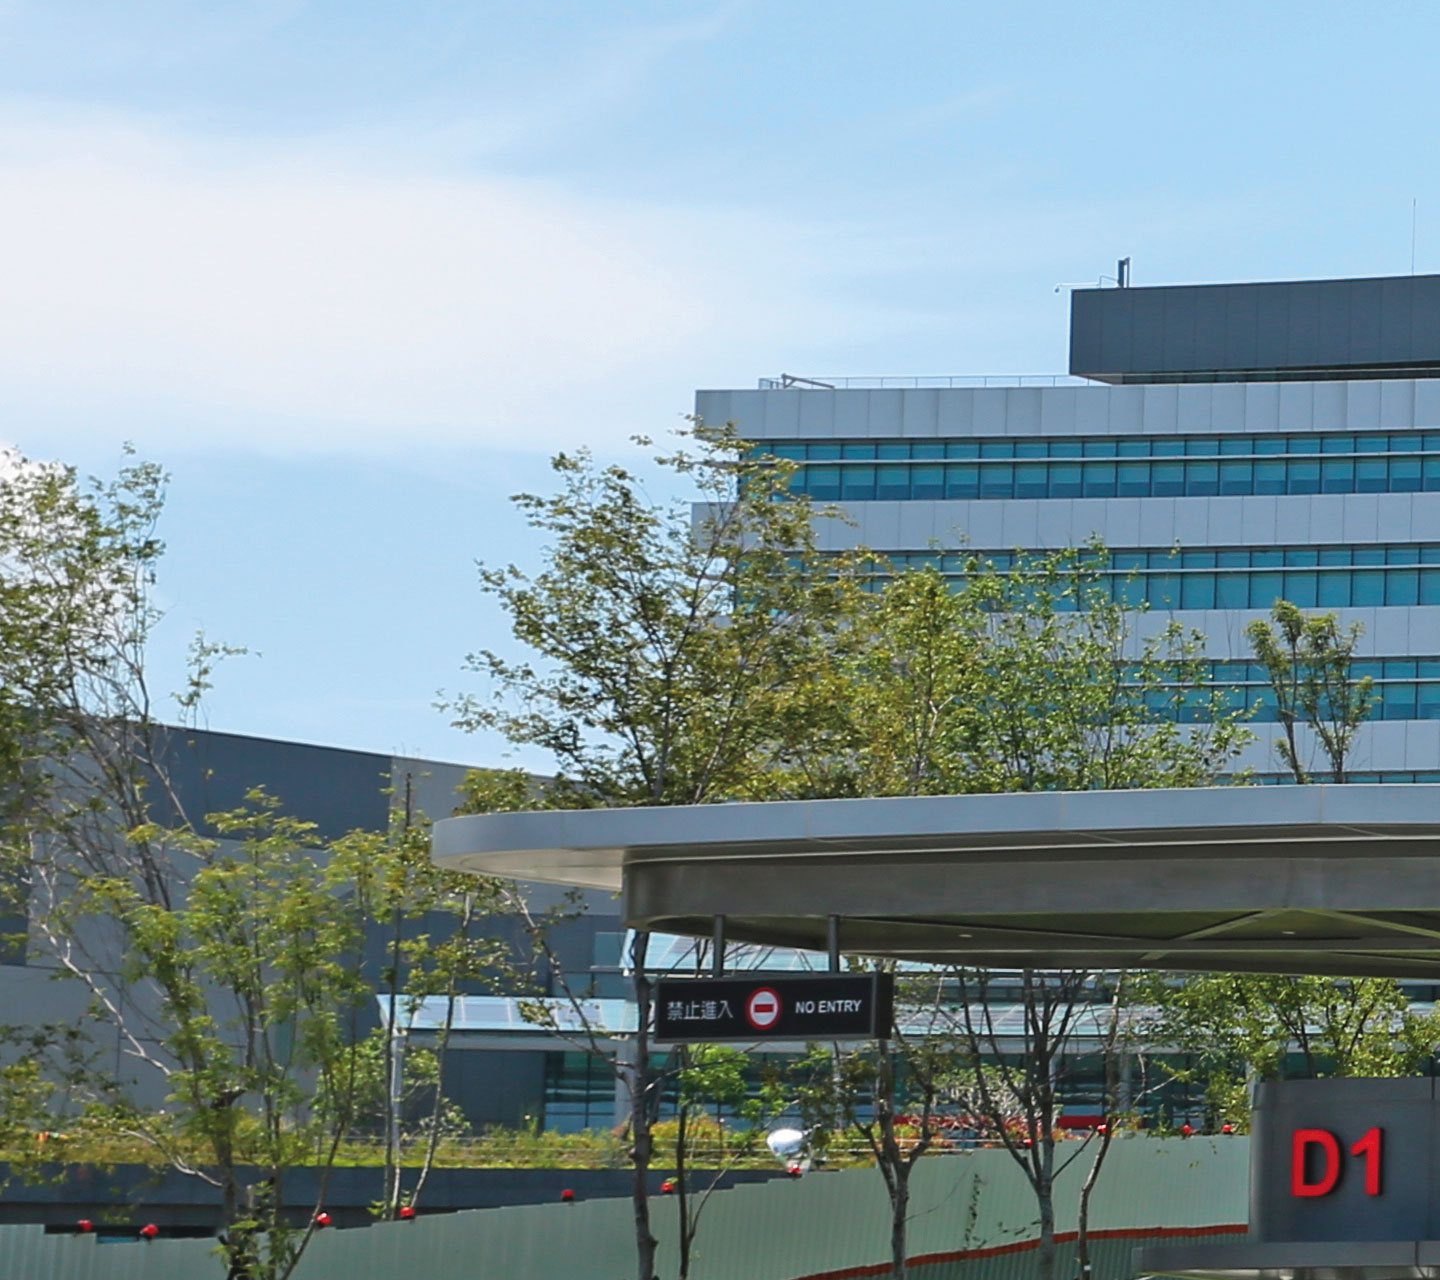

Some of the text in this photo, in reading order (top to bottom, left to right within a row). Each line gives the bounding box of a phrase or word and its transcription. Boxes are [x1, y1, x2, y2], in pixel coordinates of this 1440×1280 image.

[667, 1000, 733, 1021] 禁止進入
[795, 1000, 862, 1014] NO ENTRY
[1292, 1126, 1381, 1197] D1
